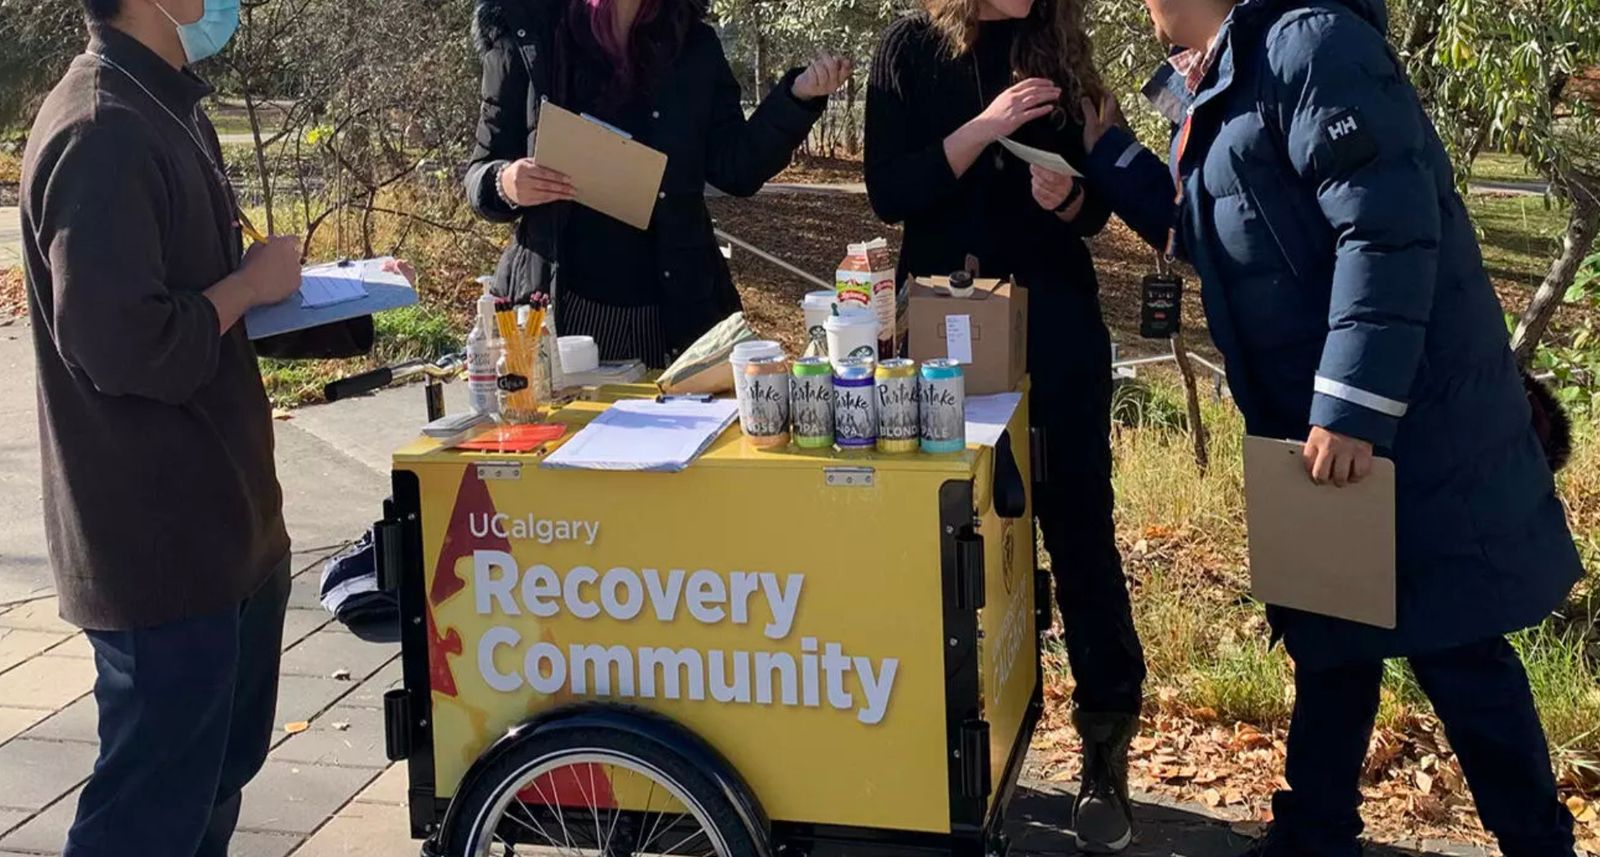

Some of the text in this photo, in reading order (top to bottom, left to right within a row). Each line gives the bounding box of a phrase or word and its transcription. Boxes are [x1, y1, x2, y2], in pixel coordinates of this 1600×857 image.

[1327, 115, 1358, 140] HH
[877, 384, 919, 407] Partak
[469, 512, 600, 545] UCalgary
[472, 549, 805, 639] Recovery
[477, 626, 899, 725] Community
